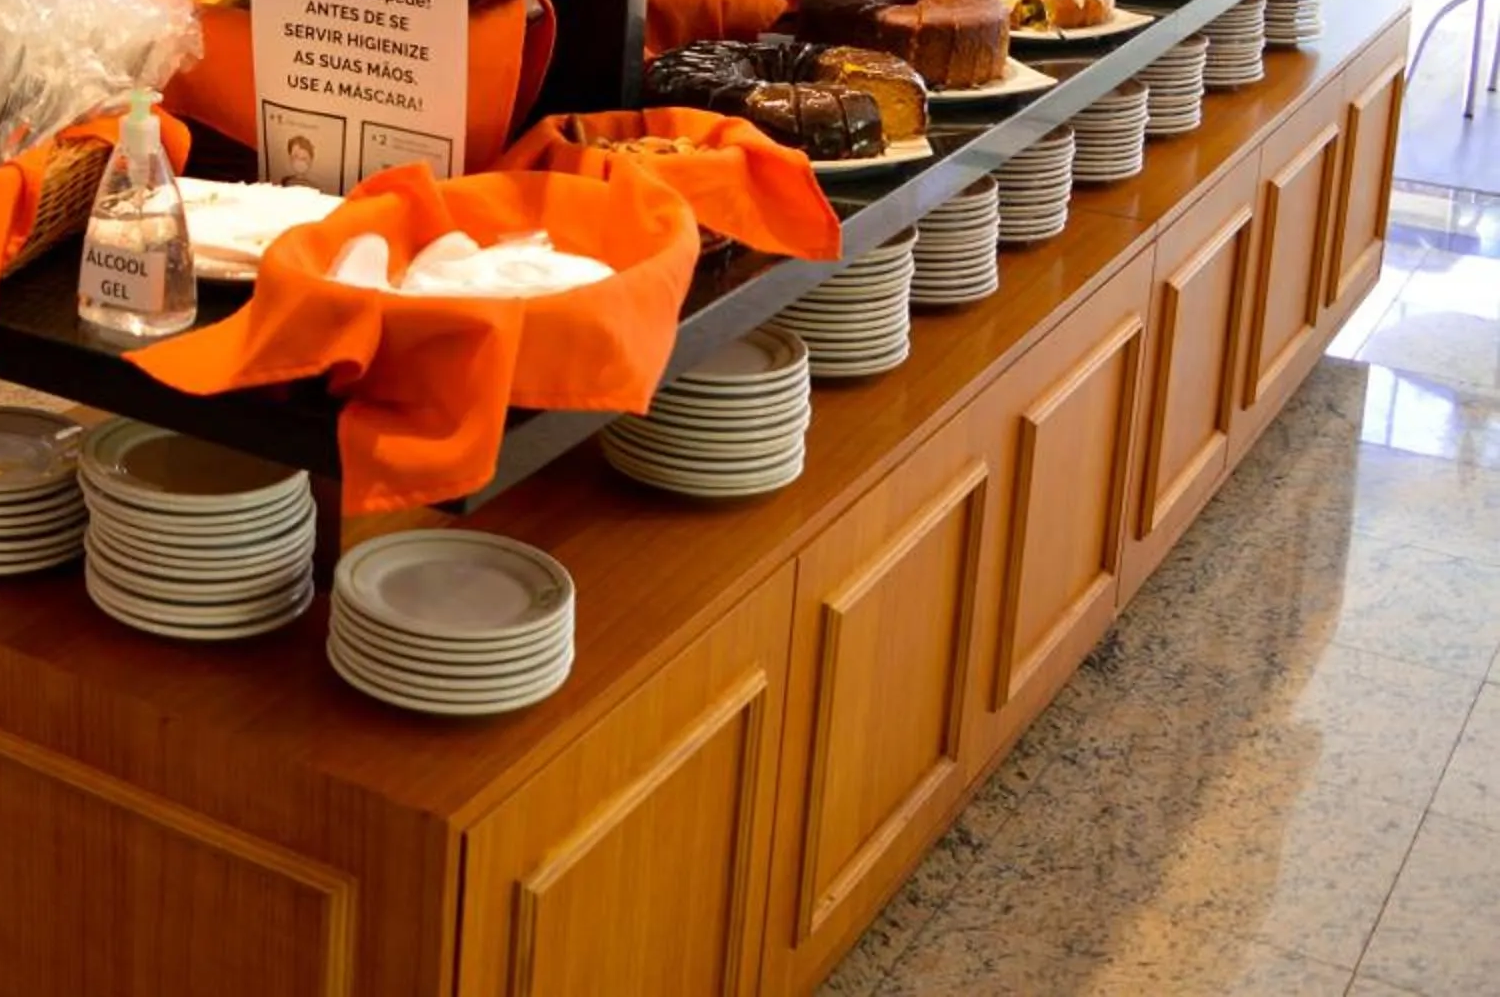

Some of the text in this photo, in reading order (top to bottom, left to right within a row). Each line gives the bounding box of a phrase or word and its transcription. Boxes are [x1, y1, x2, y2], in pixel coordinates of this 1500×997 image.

[305, 0, 410, 31] ANTES DE SE
[283, 23, 430, 61] SERVIR HIGIENIZE
[293, 50, 315, 66] AS
[319, 54, 363, 74] SUAS
[287, 74, 319, 92] USE
[323, 80, 334, 94] A
[101, 280, 129, 300] GEL
